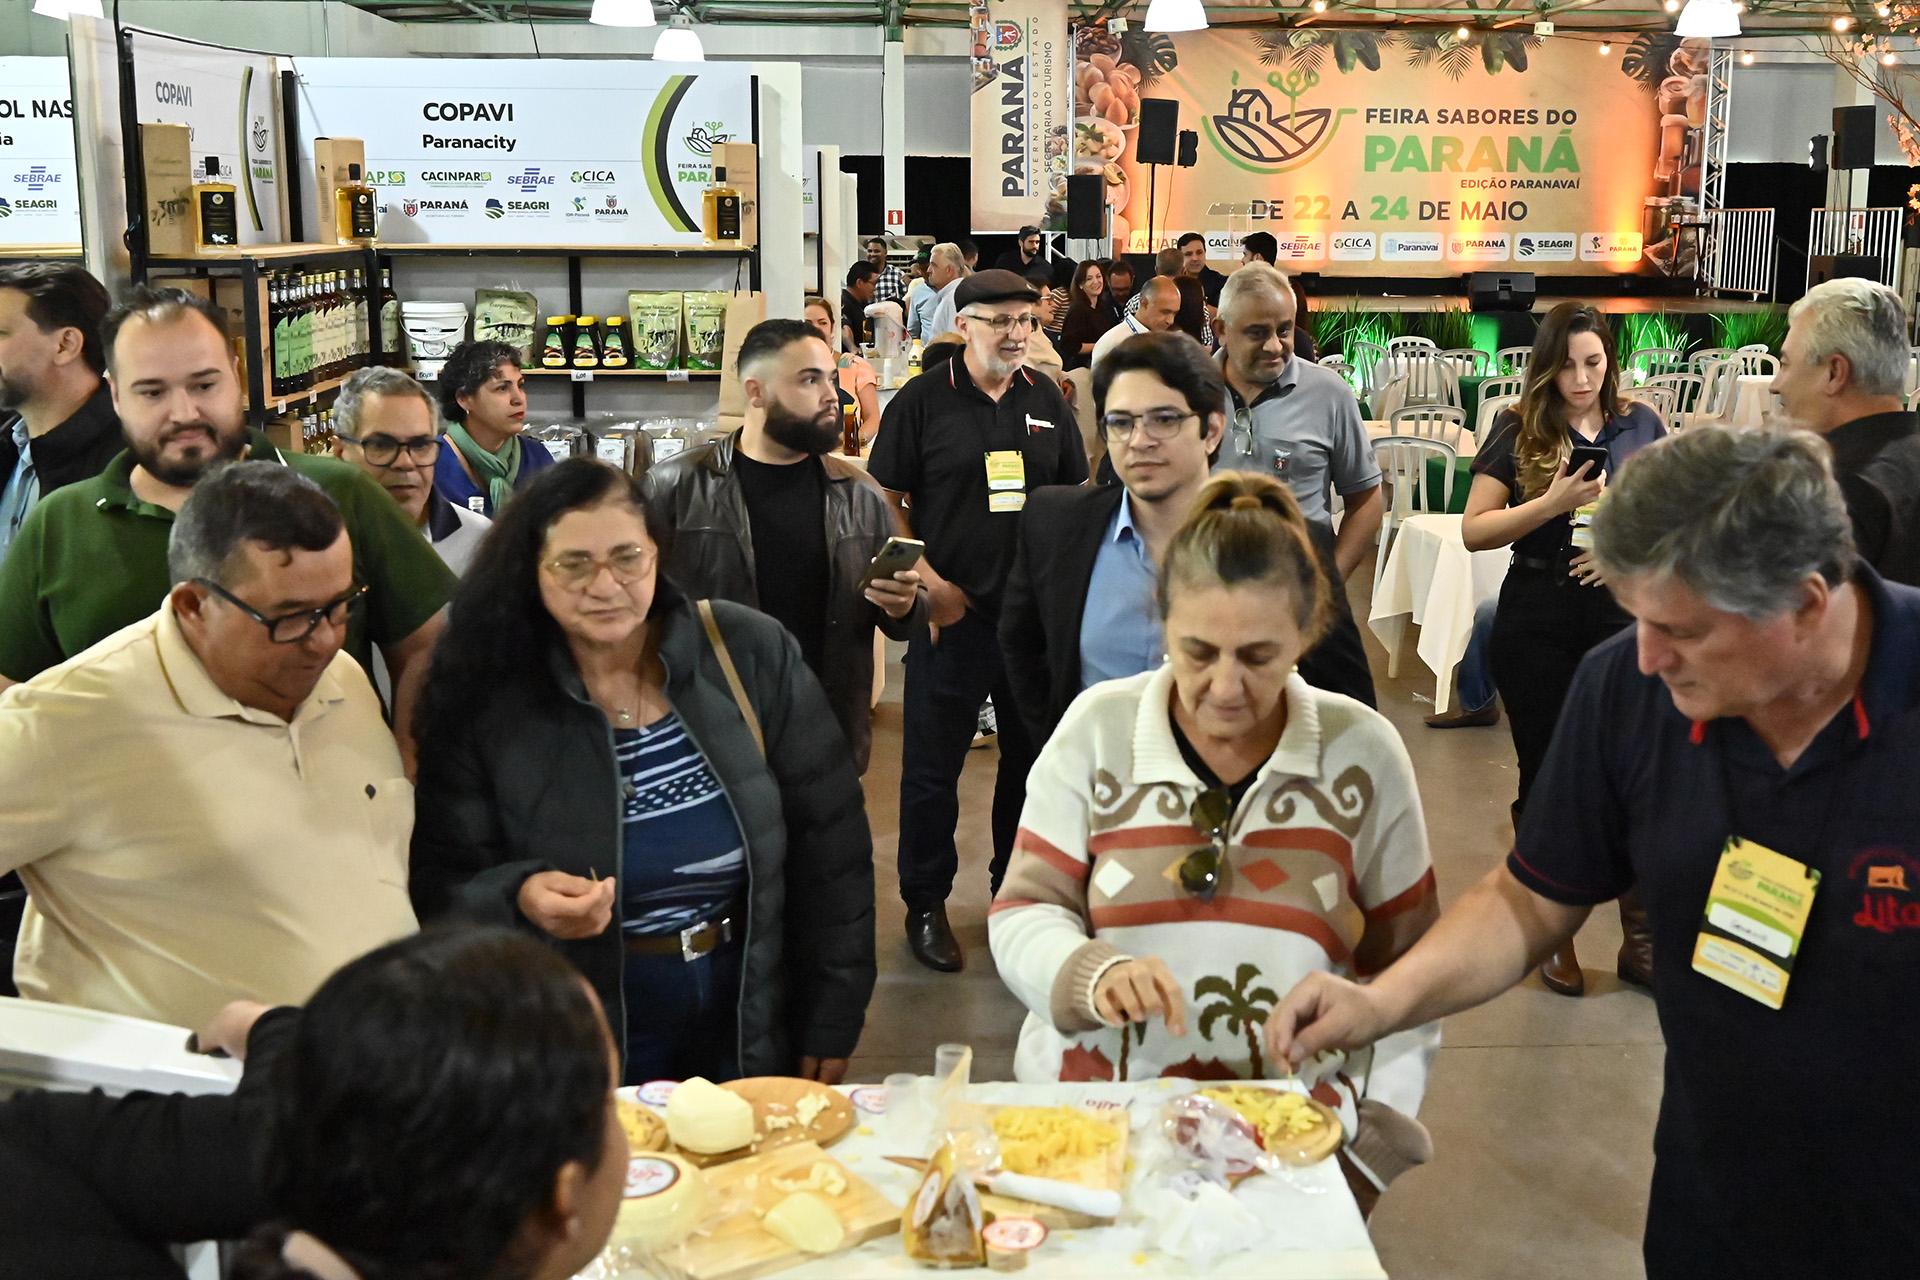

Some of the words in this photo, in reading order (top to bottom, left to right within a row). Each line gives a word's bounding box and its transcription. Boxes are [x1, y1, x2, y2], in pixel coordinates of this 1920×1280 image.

[1044, 42, 1052, 87] TURISMO
[156, 81, 192, 107] COPAVI
[1044, 91, 1052, 107] DO
[1033, 91, 1039, 110] DO
[423, 103, 513, 121] COPAVI
[1366, 108, 1429, 124] FEIRA
[1437, 109, 1539, 125] SABORES
[1546, 109, 1577, 125] DO
[997, 56, 1025, 197] PARANÁ
[423, 135, 516, 152] Paranacity
[1044, 110, 1052, 173] SECRETARIA
[1364, 129, 1580, 172] PARANÁ
[14, 174, 62, 182] SEBRAE
[421, 171, 481, 181] CACINPAR
[507, 175, 555, 185] SEBRAE
[582, 170, 615, 182] CICA
[678, 171, 711, 182] PAR
[1461, 177, 1507, 189] EDIÇÃO
[1510, 178, 1580, 189] PARANAVAÍ
[15, 200, 57, 208] SEAGRI
[420, 199, 469, 210] PARANÁ
[507, 201, 549, 210] SEAGRI
[1251, 200, 1284, 220] DE
[1293, 194, 1331, 220] 22
[1341, 200, 1360, 220] A
[1370, 195, 1409, 220] 24
[1418, 200, 1451, 221] DE
[1460, 201, 1528, 221] MAIO
[1280, 242, 1321, 250] SEBRAE
[1344, 238, 1372, 248] CICA
[1398, 243, 1440, 252] Paranavaí
[1466, 239, 1506, 248] PARANÁ
[1538, 240, 1573, 248] SEAGRI
